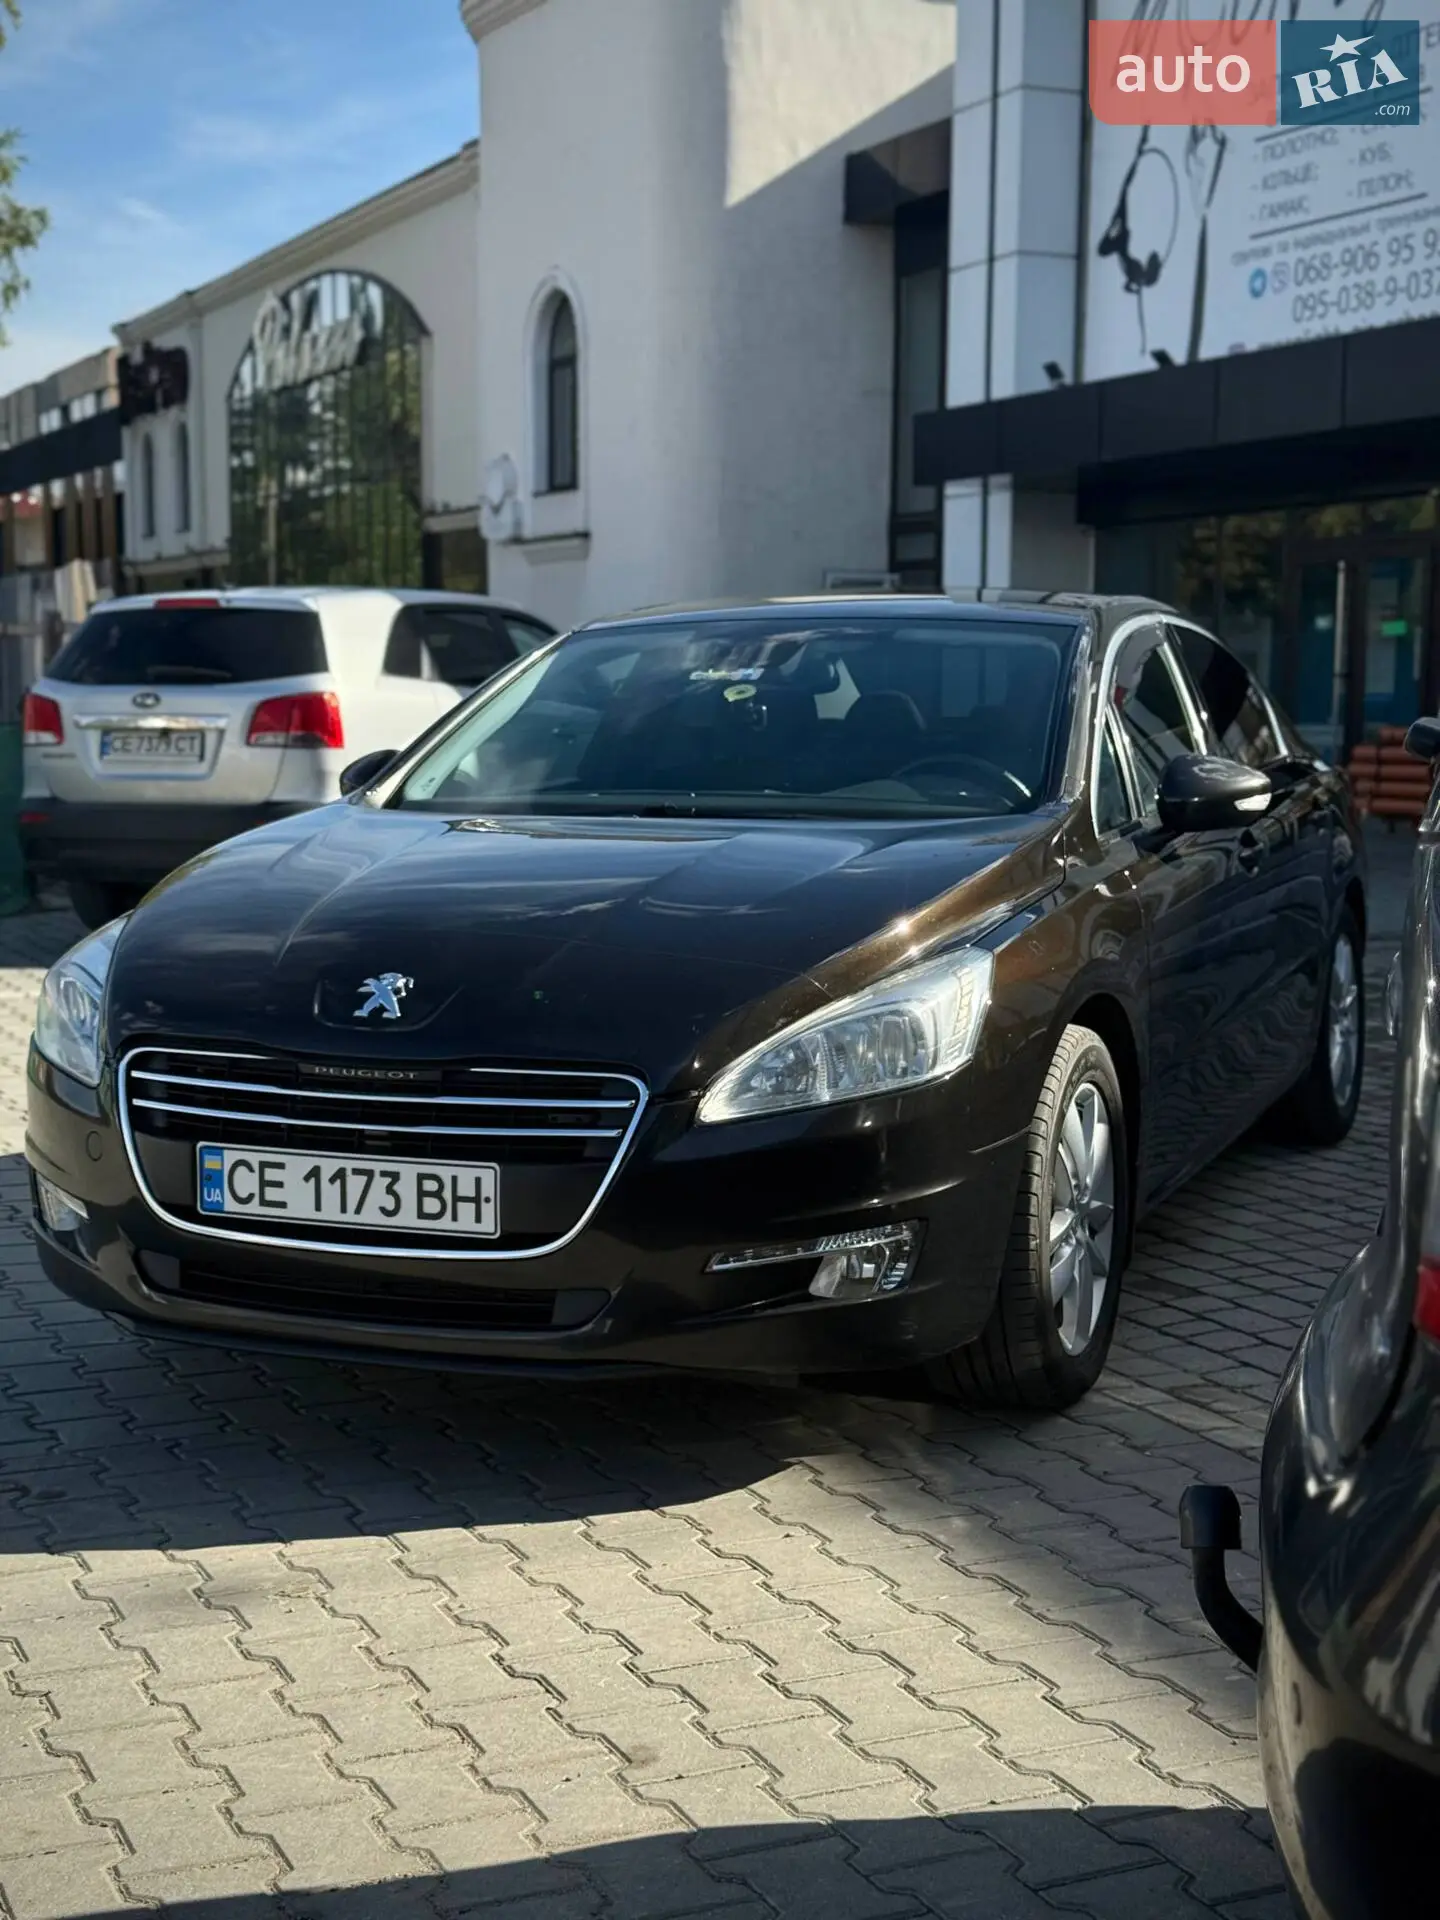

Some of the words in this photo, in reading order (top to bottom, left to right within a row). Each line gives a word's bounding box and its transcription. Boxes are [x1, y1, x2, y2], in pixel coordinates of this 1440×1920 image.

[1293, 240, 1380, 287] 068-906
[1387, 232, 1416, 268] 95
[1423, 227, 1440, 261] 9
[314, 1065, 419, 1080] PEUGEOT
[203, 1187, 223, 1204] UA
[227, 1158, 287, 1209] CE
[302, 1164, 402, 1218] 1173
[416, 1171, 482, 1224] BH
